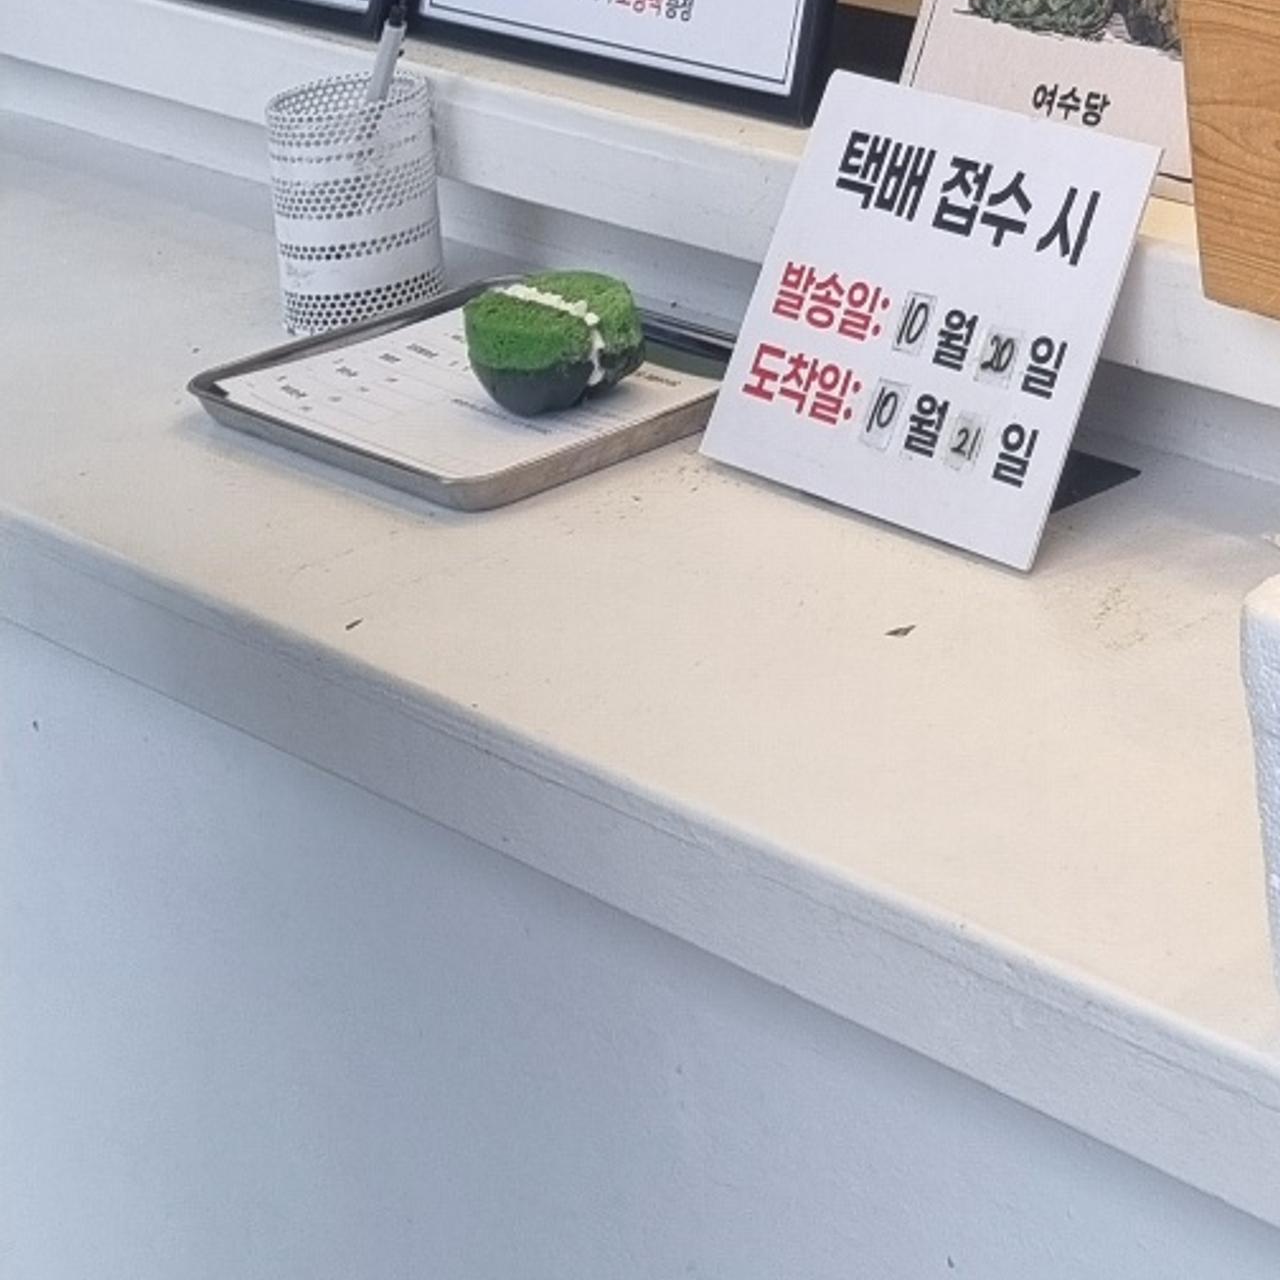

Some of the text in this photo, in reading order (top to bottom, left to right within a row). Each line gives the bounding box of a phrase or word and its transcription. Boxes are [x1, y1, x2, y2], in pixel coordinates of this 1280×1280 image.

[1032, 83, 1111, 127] 여수당
[835, 130, 1101, 268] 택배 접수 시
[772, 260, 891, 342] 발송일:
[932, 308, 979, 373] 월
[1020, 334, 1068, 400] 일
[742, 342, 862, 426] 도착일:
[904, 393, 949, 458] 월
[991, 422, 1039, 489] 일
